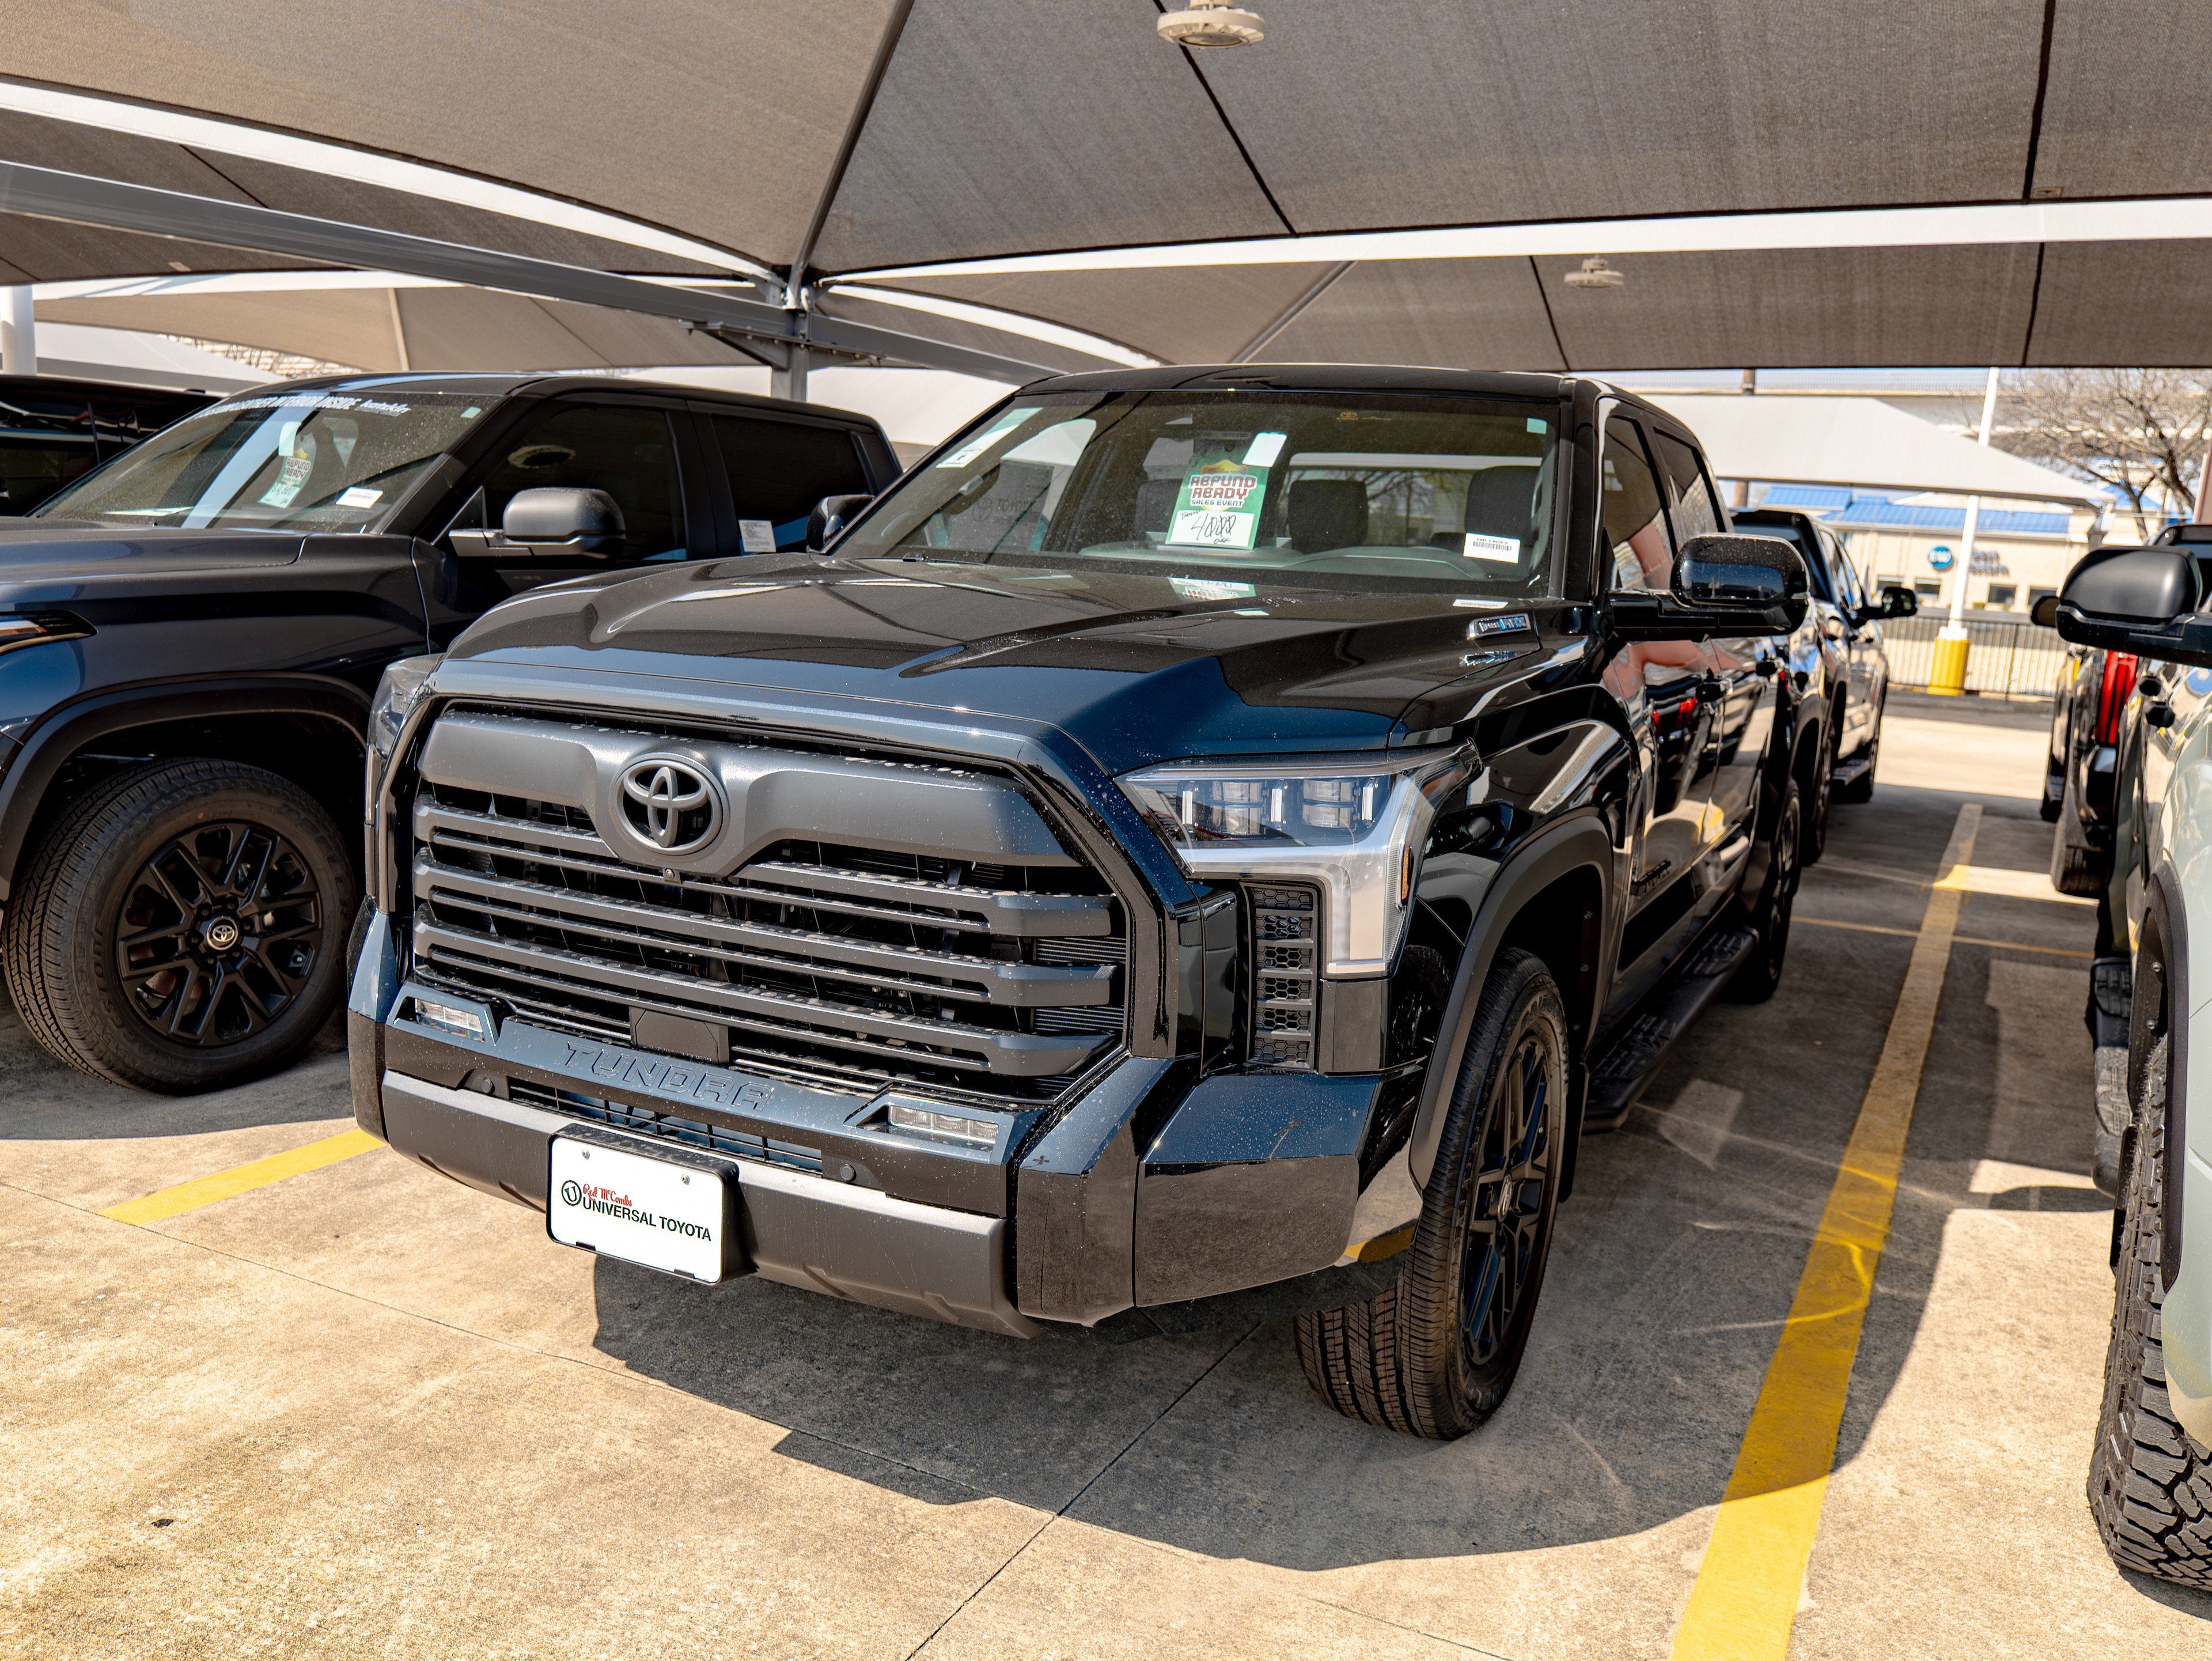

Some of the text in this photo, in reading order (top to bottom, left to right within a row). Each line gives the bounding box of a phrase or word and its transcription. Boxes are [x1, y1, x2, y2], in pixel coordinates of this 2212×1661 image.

[316, 395, 362, 410] INSIDE
[1190, 475, 1257, 489] REFUND
[1192, 487, 1248, 500] READY
[563, 1041, 773, 1111] TUNDRA
[582, 1183, 632, 1207] Red McCombs
[582, 1196, 711, 1242] UNIVERSAL TOYOTA
